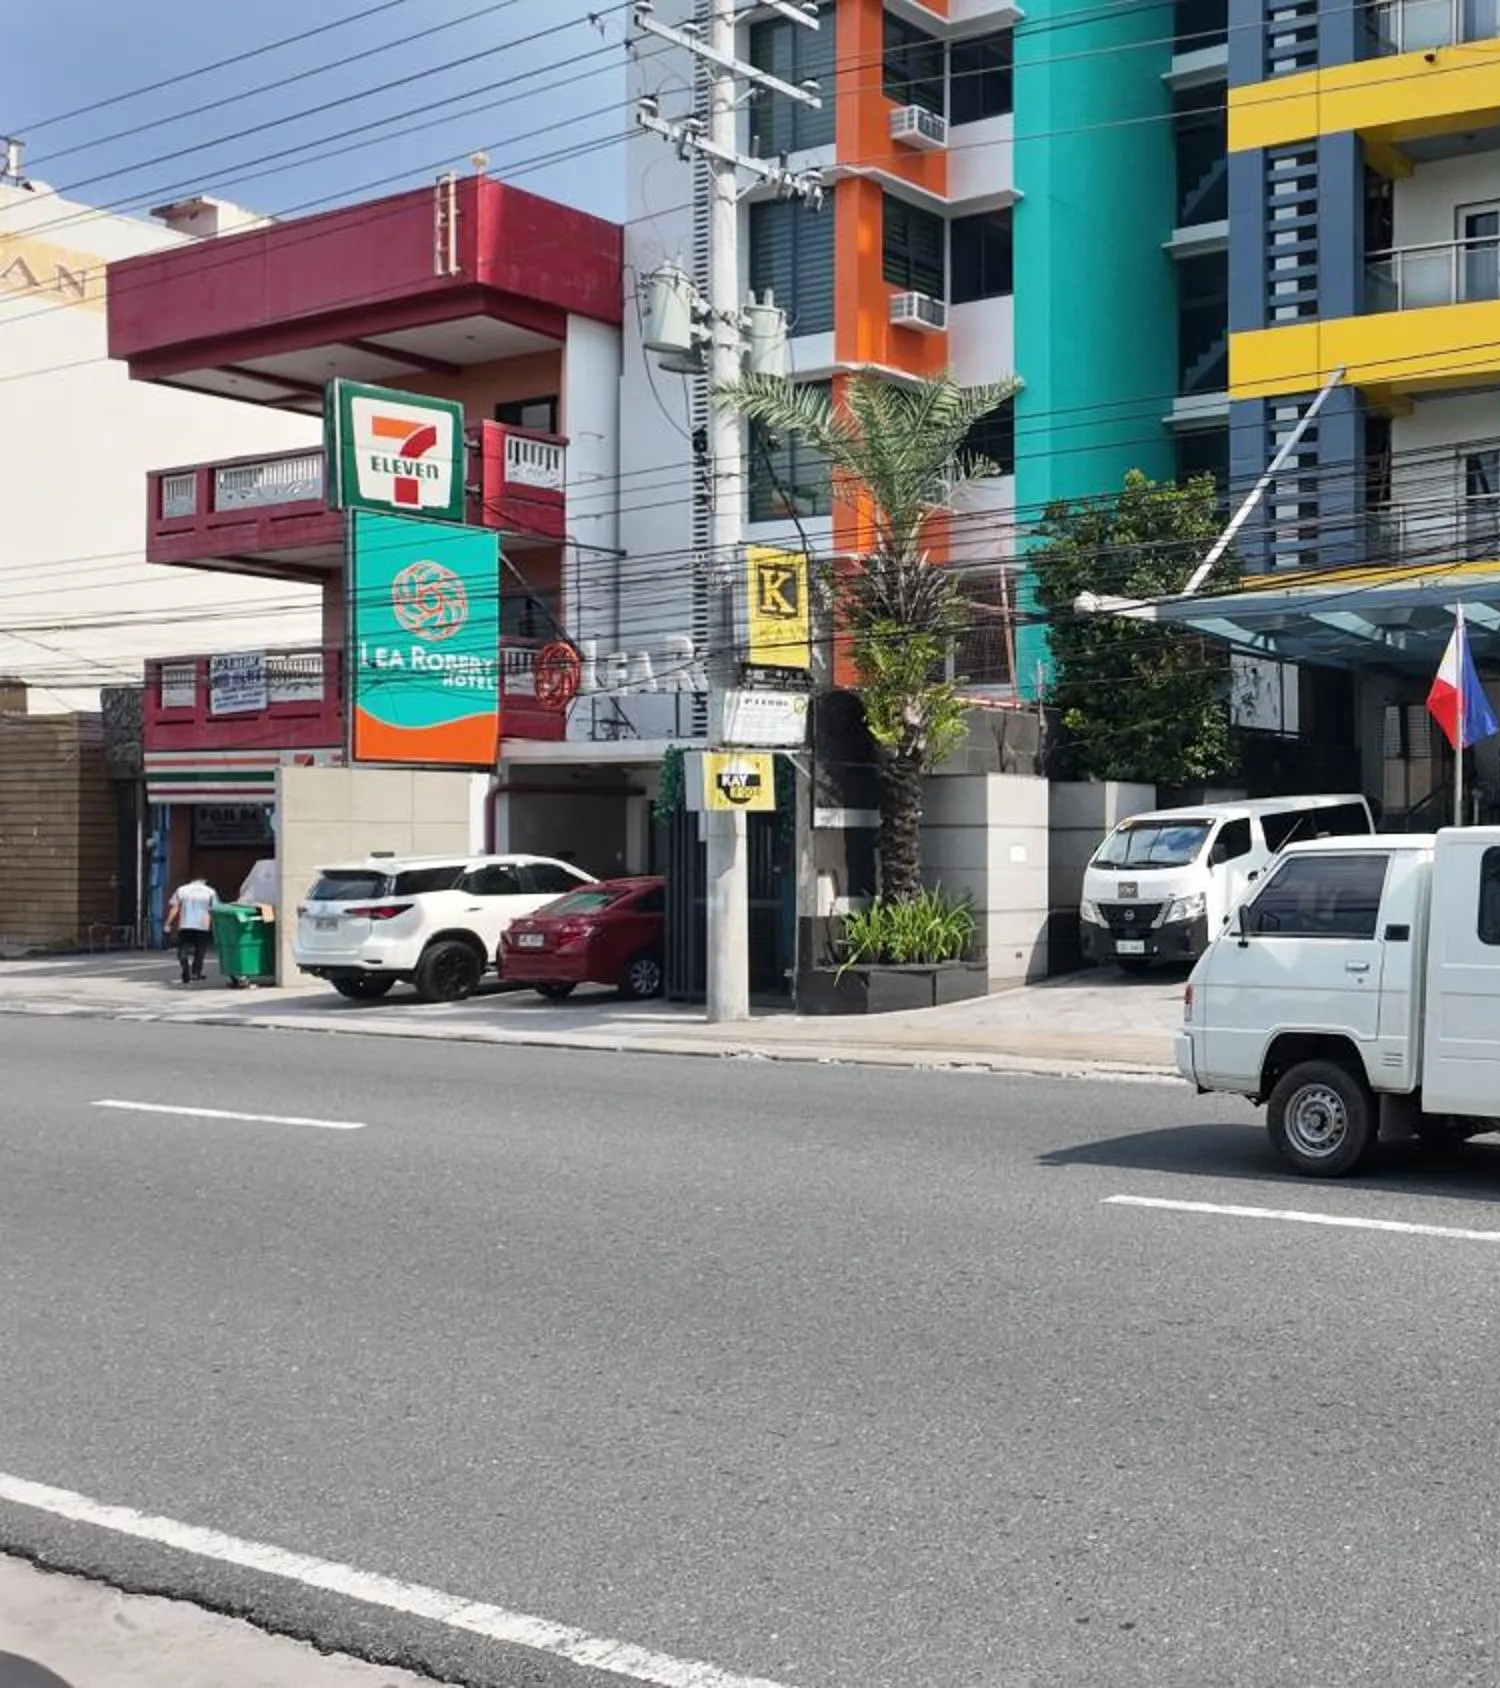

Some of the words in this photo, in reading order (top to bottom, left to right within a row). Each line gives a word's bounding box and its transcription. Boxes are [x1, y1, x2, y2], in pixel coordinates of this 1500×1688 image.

[759, 568, 797, 613] K
[360, 641, 405, 668] LEA
[442, 672, 495, 691] HOTEL
[721, 773, 748, 787] KAY
